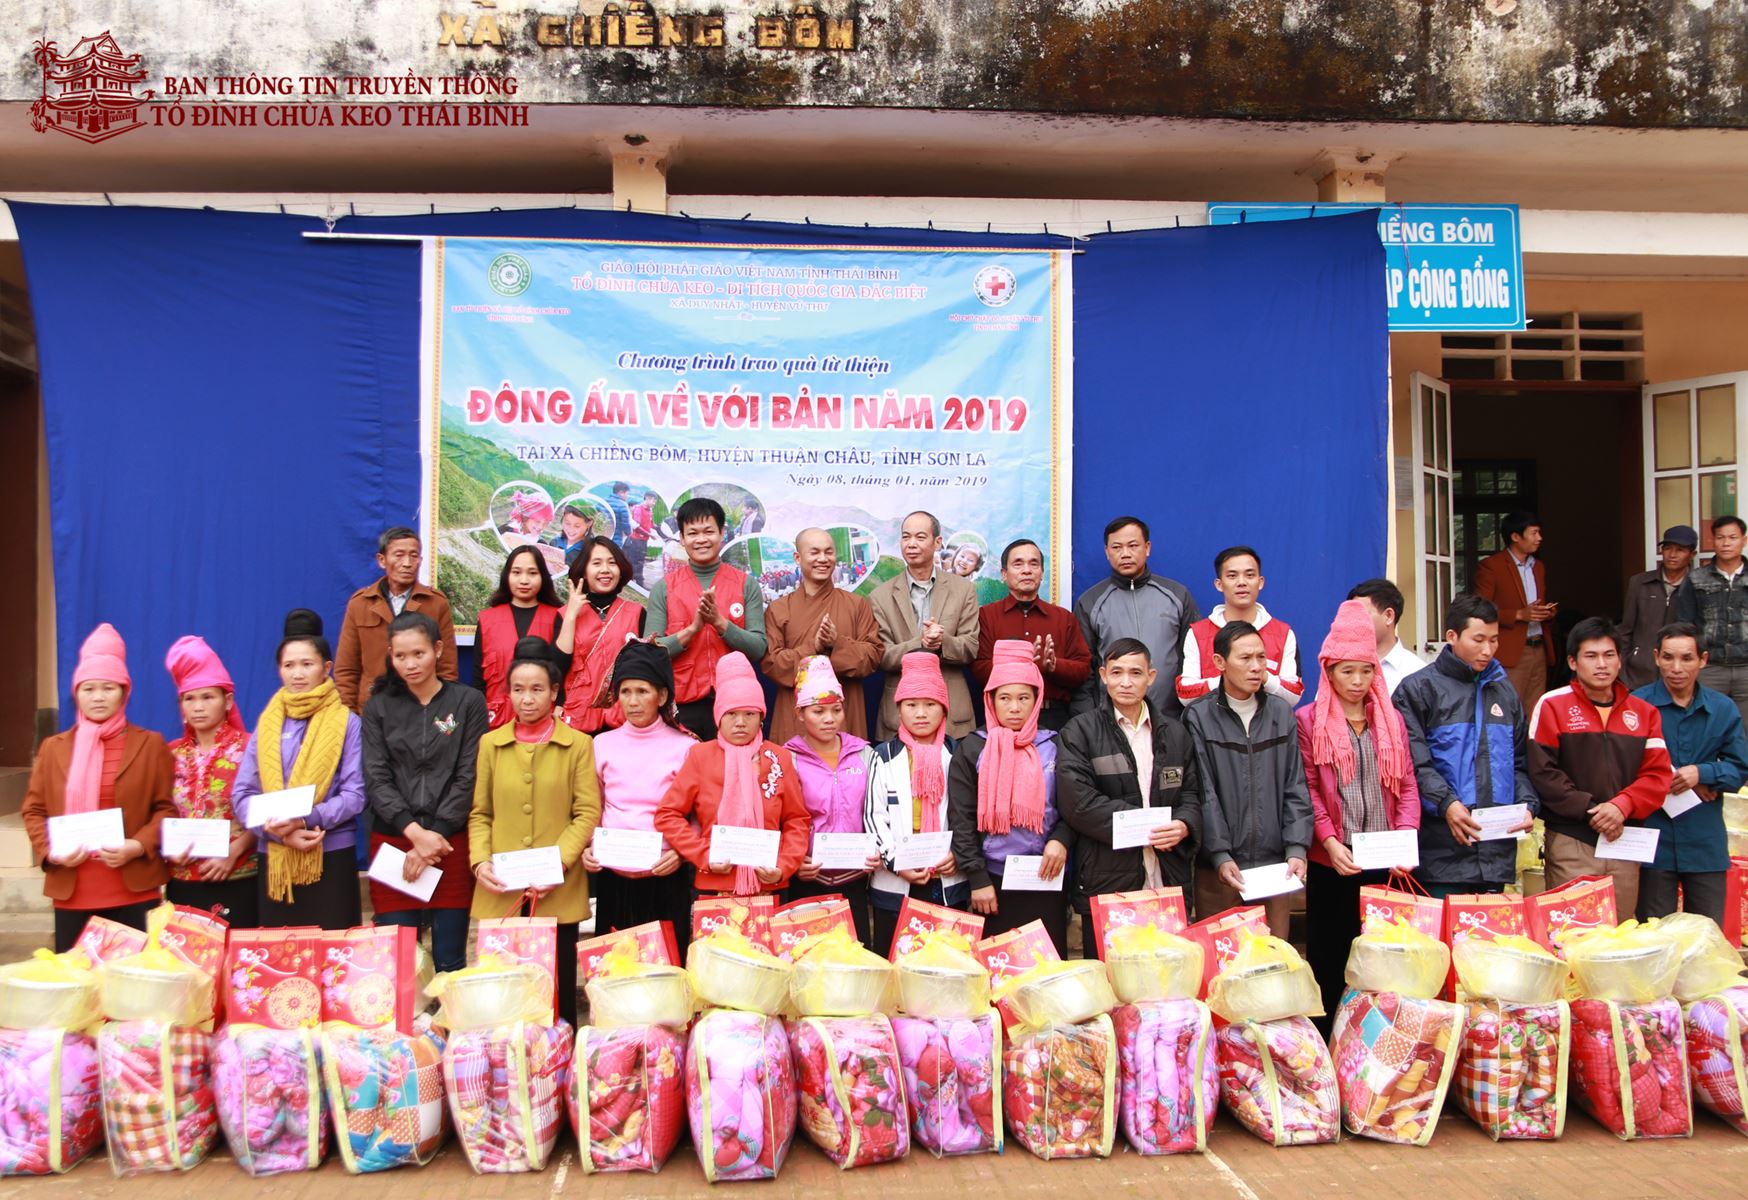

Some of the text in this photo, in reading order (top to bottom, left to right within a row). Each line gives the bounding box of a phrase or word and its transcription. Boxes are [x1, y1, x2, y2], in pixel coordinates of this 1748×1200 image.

[757, 5, 855, 50] BÔM
[1377, 214, 1494, 243] IỀNG BÔM
[601, 261, 899, 281] GIÁO HỘI PHẬT GIÁO VIỆT NAM TỈNH THÁI BÌNH
[572, 273, 593, 291] TỔ
[597, 276, 635, 291] ĐÌNH
[639, 278, 681, 294] CHÙA
[685, 282, 713, 294] KEO
[747, 279, 782, 296] TÍCH
[785, 281, 828, 298] QUỐC
[830, 286, 856, 298] GIA
[860, 285, 891, 301] ĐẶC
[895, 284, 927, 301] BIỆT
[1408, 260, 1458, 317] CỘNG
[1461, 255, 1510, 308] ĐỒNG
[689, 299, 710, 309] DUY
[751, 301, 790, 312] HUYỆN
[618, 353, 889, 377] Chương trình trao quà từ thiện
[467, 381, 1028, 431] ĐÔNG ẤM VỀ VỚI BẢN NĂM 2019
[517, 440, 987, 467] TẠI XÃ CHIỀNG BÔM, HUYỆN THUẬN CHÂU, TỈNH SƠN LA
[786, 473, 823, 487] Ngày
[826, 474, 847, 485] 08,
[851, 474, 891, 487] tháng
[919, 476, 949, 486] năm
[954, 476, 988, 487] 2019
